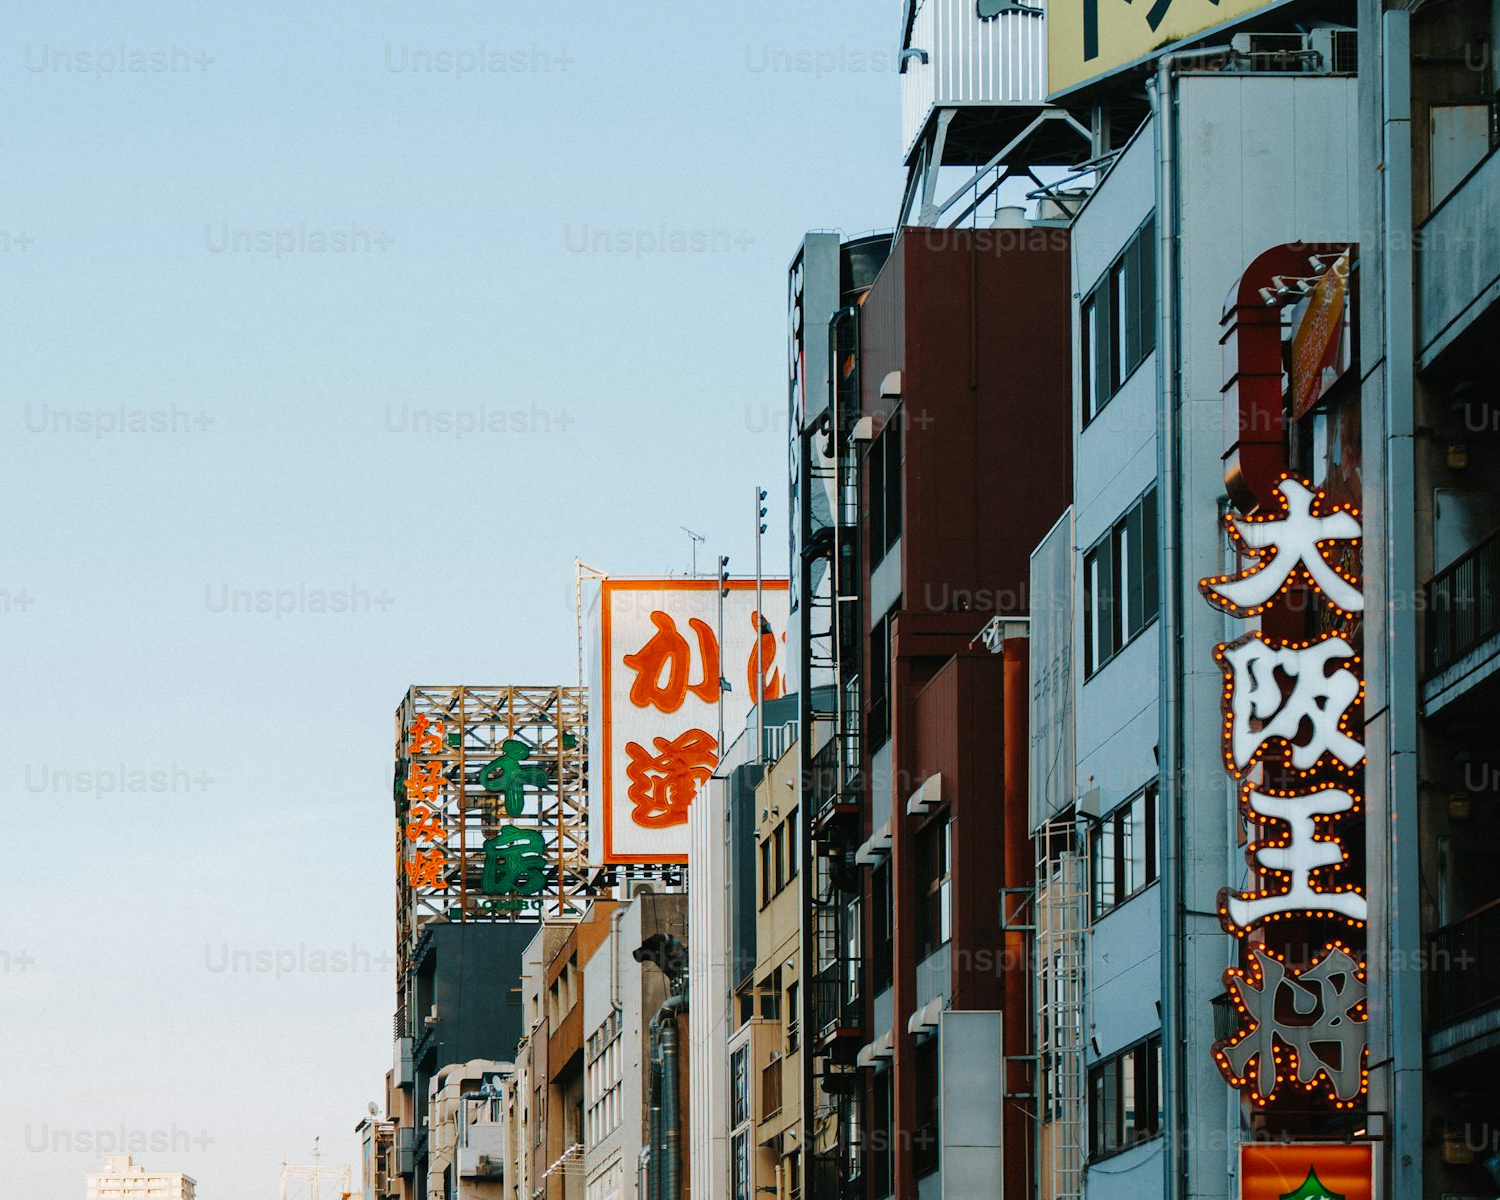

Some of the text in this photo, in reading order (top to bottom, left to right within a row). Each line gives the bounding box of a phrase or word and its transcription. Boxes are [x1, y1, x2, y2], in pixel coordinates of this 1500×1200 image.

[404, 713, 448, 888] お好み焼
[1209, 480, 1370, 1100] 大阪王将
